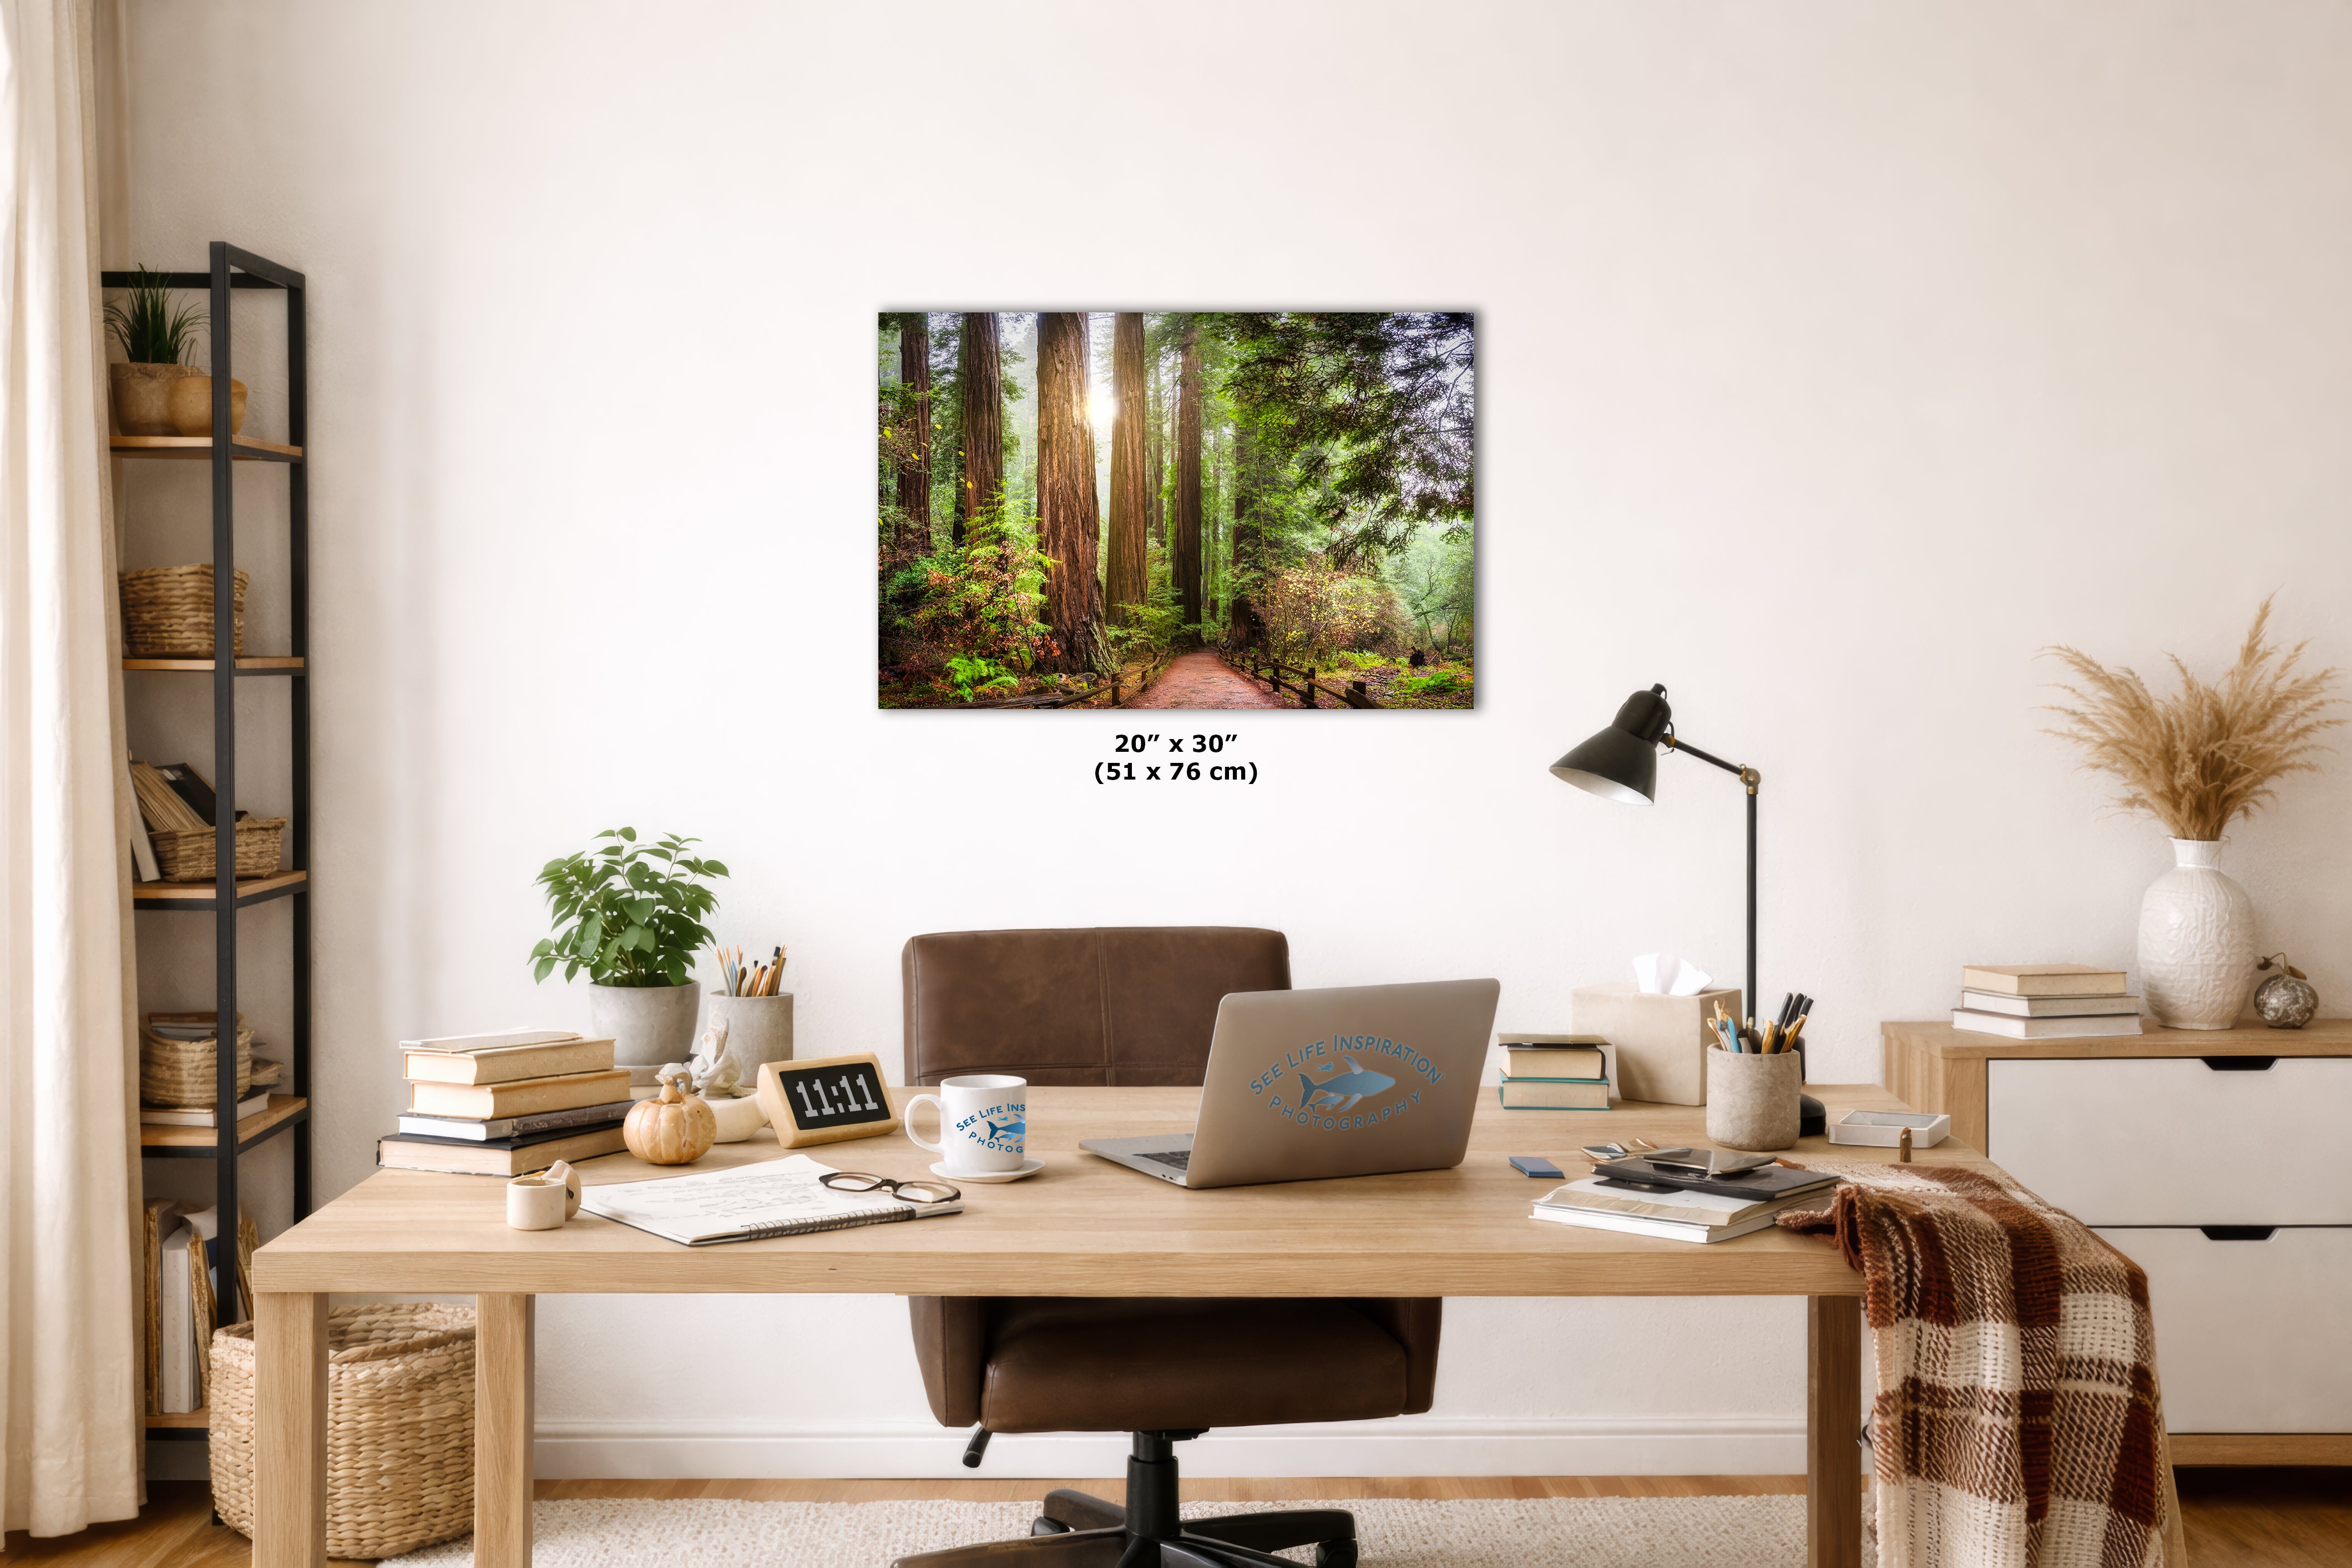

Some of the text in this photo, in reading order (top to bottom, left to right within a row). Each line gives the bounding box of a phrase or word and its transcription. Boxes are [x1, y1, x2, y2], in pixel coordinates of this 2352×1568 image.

[1250, 1063, 1283, 1095] SEE
[1286, 1040, 1326, 1069] LIFE
[796, 1074, 878, 1117] 11:11
[1269, 1089, 1421, 1130] PHOTOGRAPHY
[956, 1115, 977, 1131] SEE
[979, 1105, 1003, 1119] LIFE
